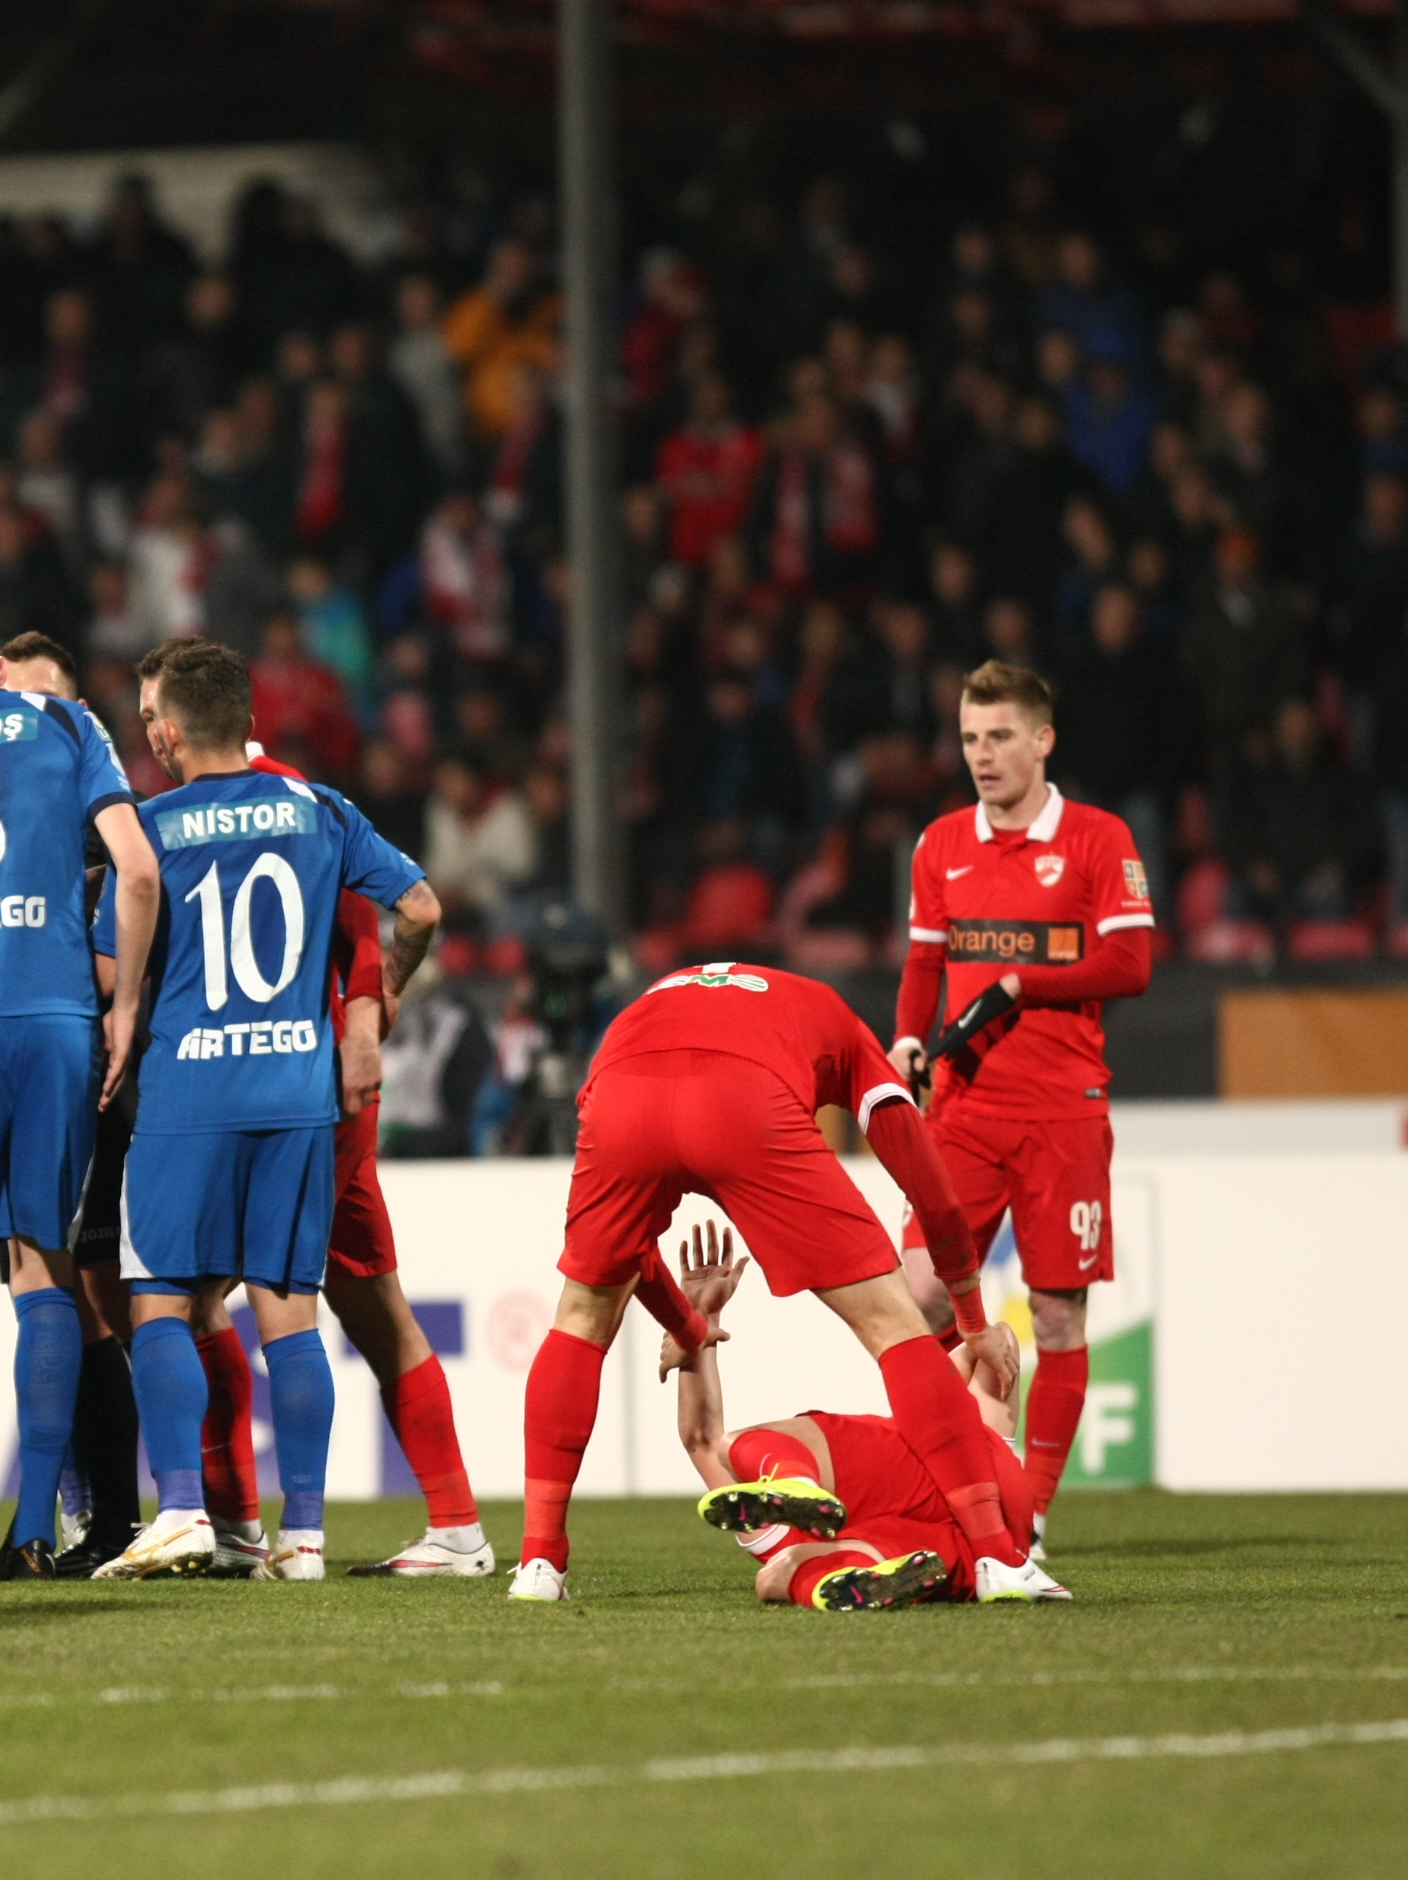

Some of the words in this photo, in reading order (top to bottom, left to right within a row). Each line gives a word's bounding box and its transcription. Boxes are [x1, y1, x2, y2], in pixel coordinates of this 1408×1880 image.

[182, 802, 296, 839] NISTOR
[185, 852, 305, 1012] 10
[177, 1019, 317, 1060] ARTEGO
